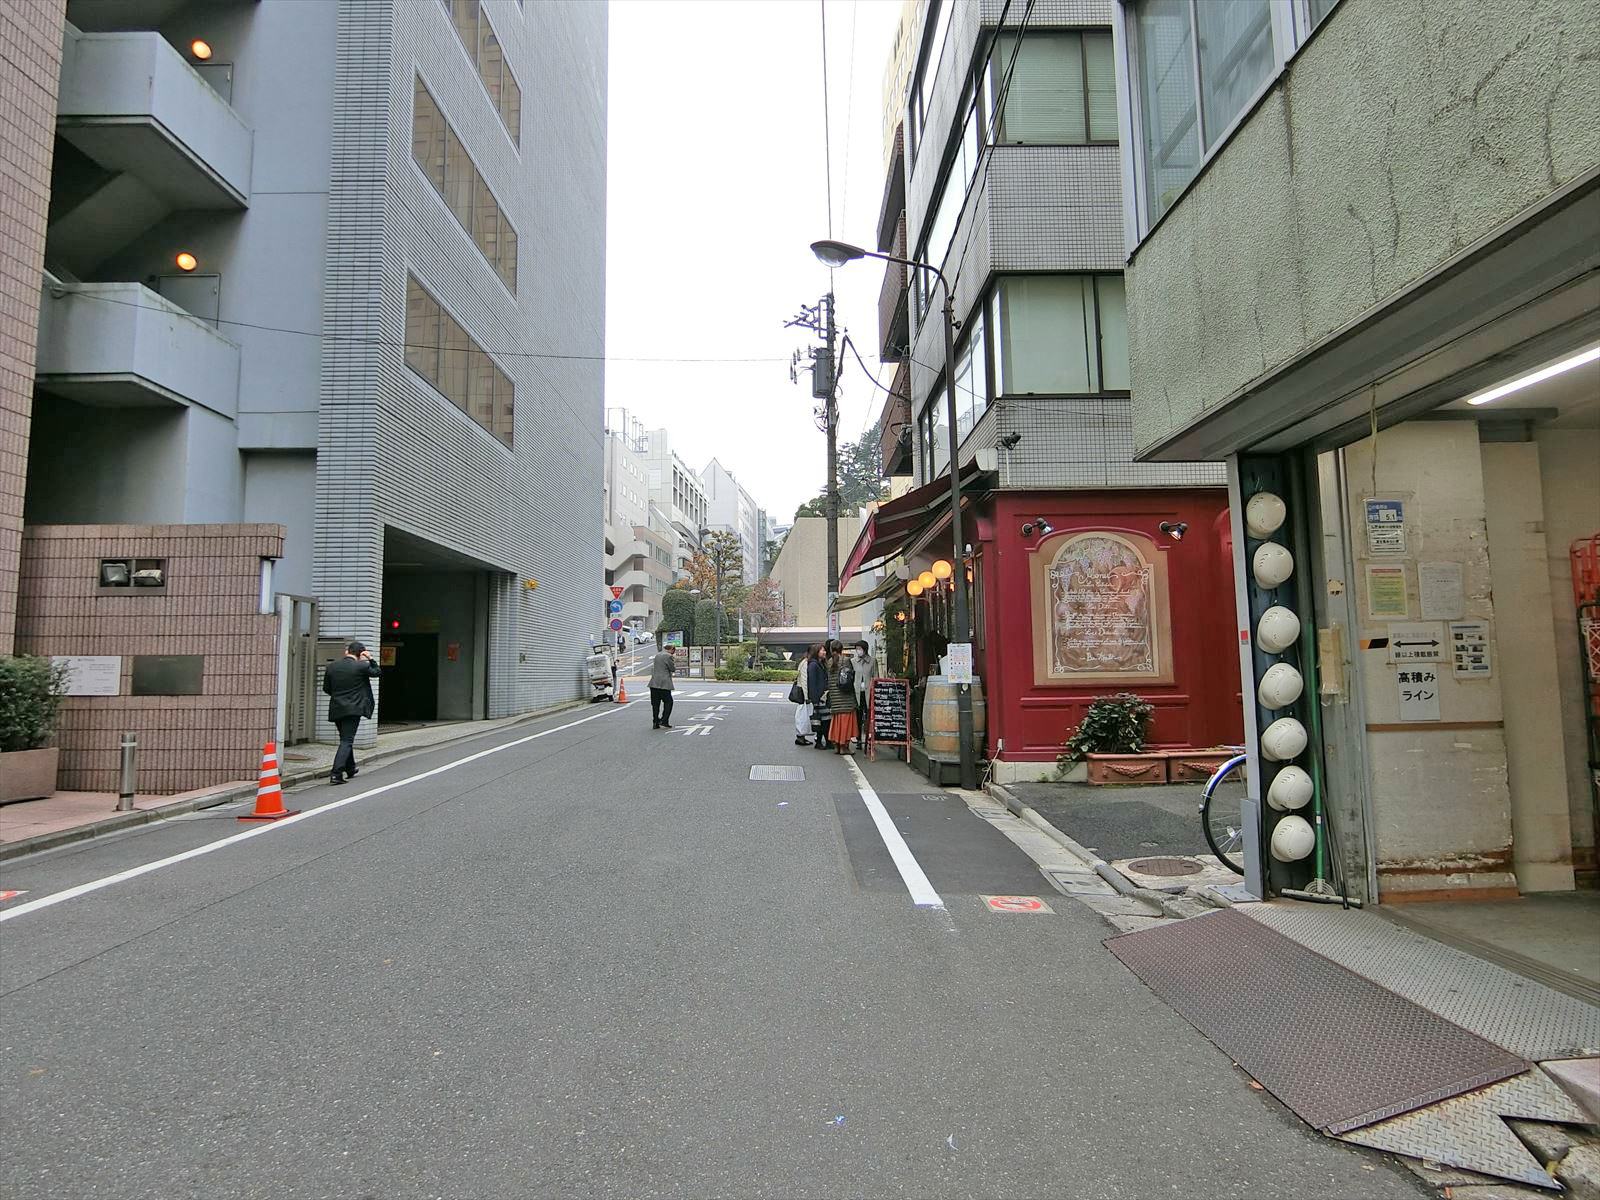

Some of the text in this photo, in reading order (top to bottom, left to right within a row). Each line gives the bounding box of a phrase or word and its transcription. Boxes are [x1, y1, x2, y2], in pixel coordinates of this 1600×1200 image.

[1402, 690, 1434, 701] ライン
[665, 705, 736, 736] 止まれ
